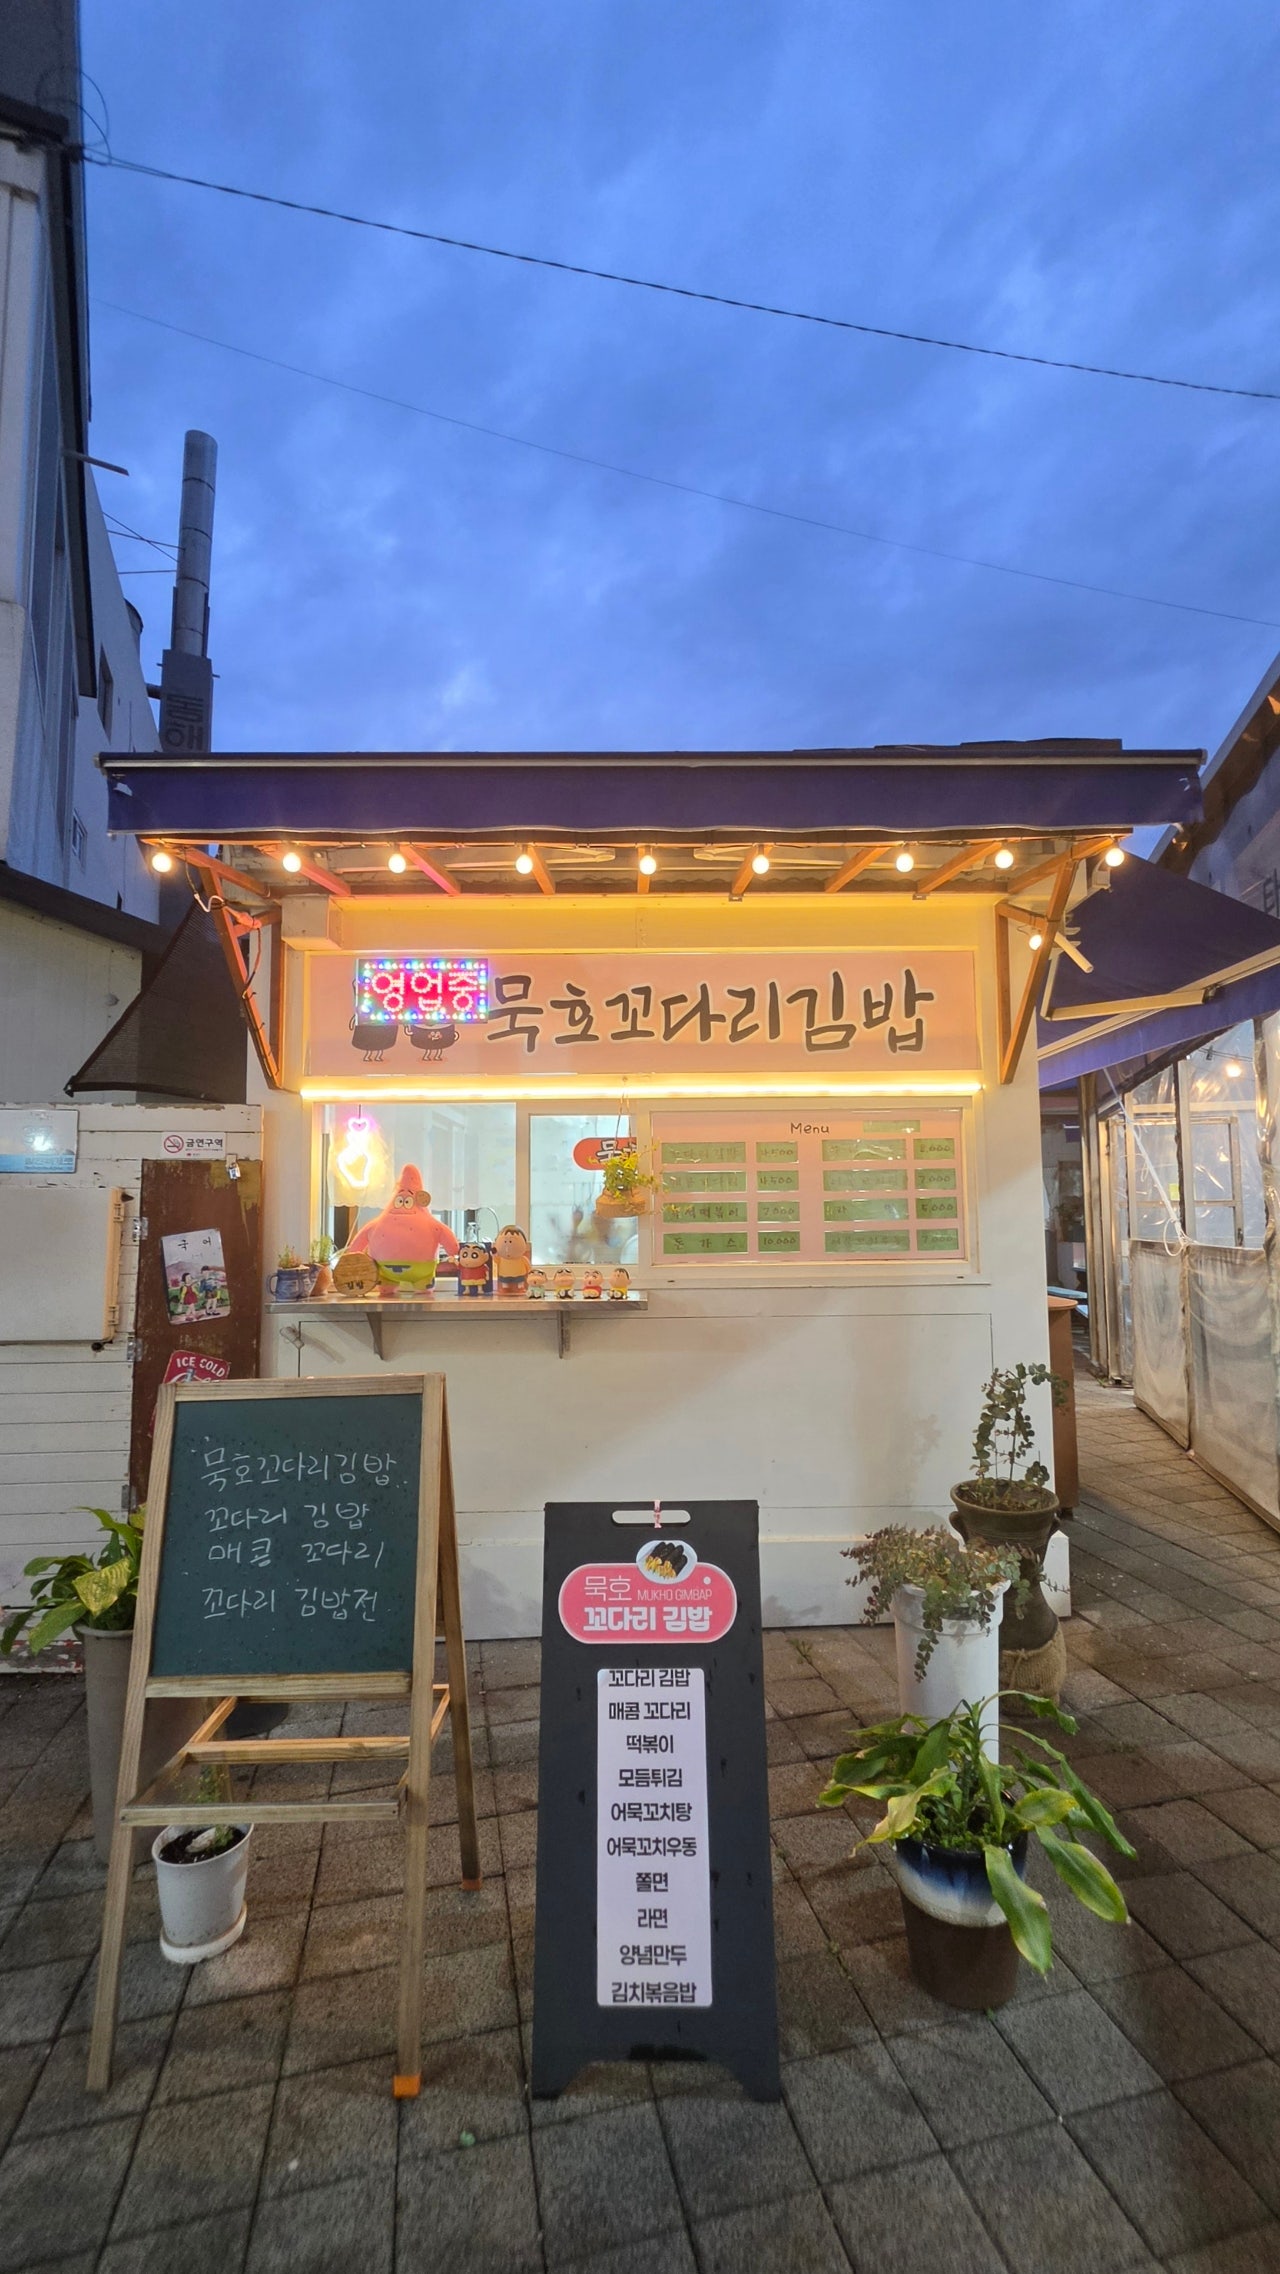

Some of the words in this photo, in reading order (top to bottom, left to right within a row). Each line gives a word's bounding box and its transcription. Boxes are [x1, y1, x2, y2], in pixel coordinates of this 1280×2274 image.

[372, 972, 478, 1012] 영업중
[487, 968, 934, 1054] 묵호꼬다리김밥
[790, 1122, 830, 1134] Menu
[186, 1138, 223, 1148] 금연구역
[176, 1356, 196, 1368] ICE
[199, 1358, 225, 1378] COLD
[204, 1506, 287, 1532] 꼬다리
[301, 1541, 385, 1568] 꼬다리
[584, 1574, 631, 1602] 묵호
[637, 1589, 673, 1602] MUKHO
[675, 1588, 713, 1601] GIMBAP
[202, 1587, 275, 1620] 꼬다리
[295, 1587, 378, 1622] 김밥전
[583, 1606, 657, 1632] 꼬다리
[663, 1606, 713, 1632] 김밥
[608, 1669, 655, 1688] 꼬다리
[659, 1669, 691, 1688] 김밥
[608, 1702, 640, 1721] 매콤
[643, 1702, 690, 1721] 꼬다리
[626, 1734, 674, 1754] 떡볶이
[618, 1768, 683, 1788] 모듬튀김
[610, 1802, 693, 1822] 어묵꼬치탕
[606, 1836, 698, 1858] 어묵꼬치우동
[635, 1871, 669, 1893] 쫄면
[637, 1908, 668, 1930] 라면
[619, 1944, 688, 1967] 양념만두
[611, 1981, 697, 2004] 김치볶음밥
